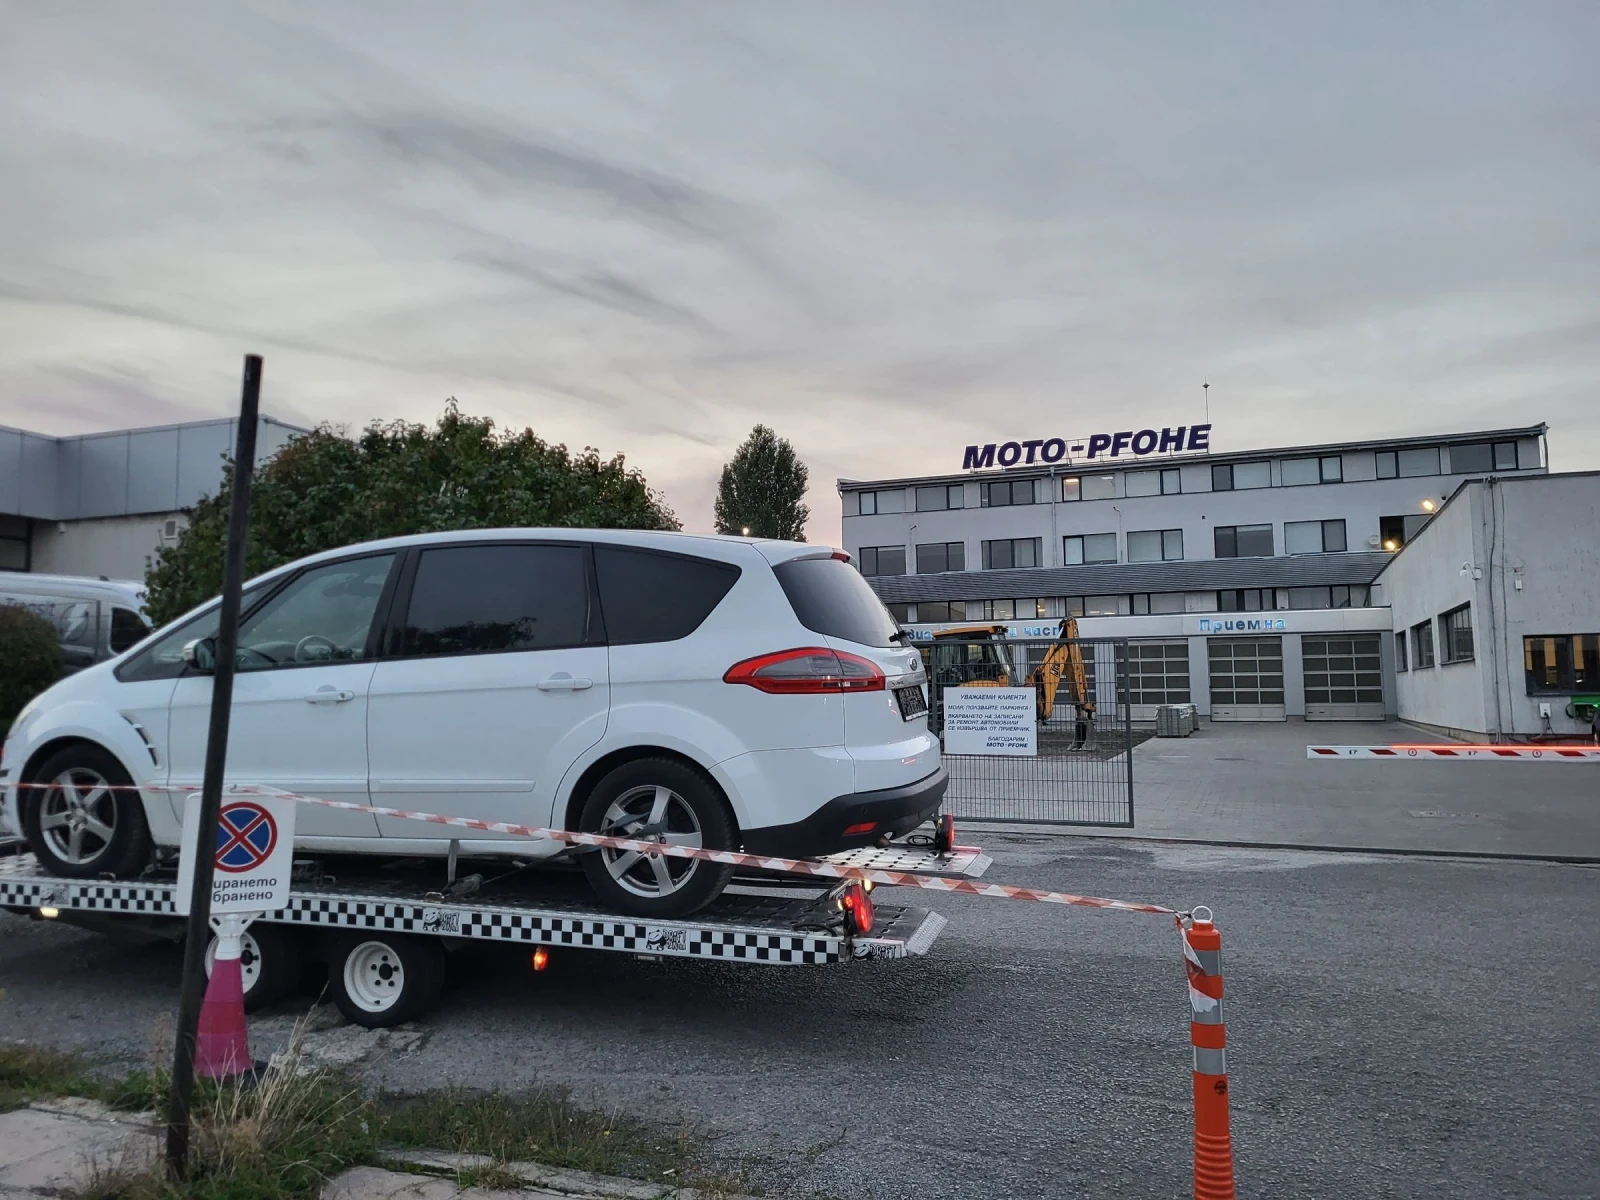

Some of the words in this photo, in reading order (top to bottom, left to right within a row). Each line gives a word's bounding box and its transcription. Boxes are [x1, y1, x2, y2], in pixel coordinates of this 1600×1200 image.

[962, 424, 1212, 470] MOTO-PFOHE
[1199, 618, 1286, 633] Приемна
[213, 878, 277, 891] ирането
[212, 890, 273, 904] бранено
